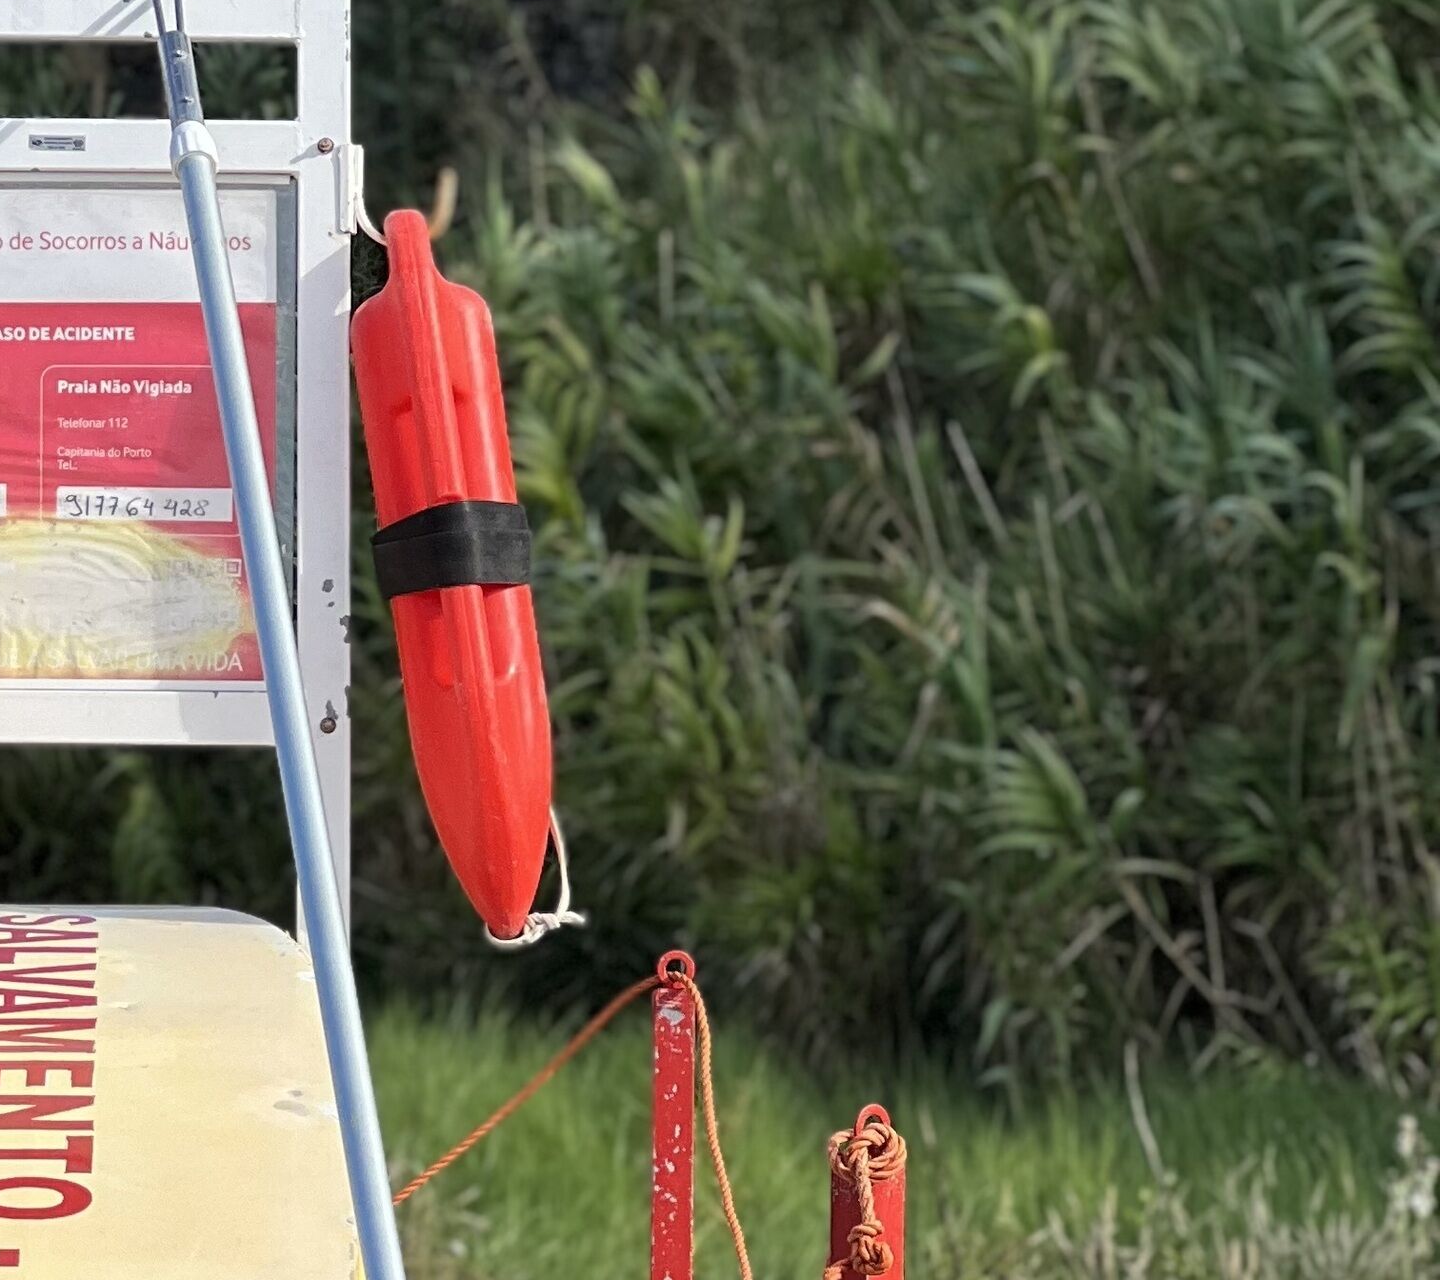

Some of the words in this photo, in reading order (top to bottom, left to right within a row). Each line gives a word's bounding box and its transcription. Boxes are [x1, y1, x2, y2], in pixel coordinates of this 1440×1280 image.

[9, 231, 34, 250] de
[39, 231, 127, 250] Socorros
[132, 235, 143, 250] a
[149, 231, 252, 251] Náuos
[28, 326, 49, 341] DE
[53, 326, 135, 341] ACIDENTE
[57, 379, 97, 394] Praia
[100, 378, 131, 394] Não
[133, 379, 192, 396] Vigiada
[57, 417, 106, 429] Telefonar
[108, 417, 129, 429] 112
[57, 446, 105, 459] Capitania
[107, 447, 121, 458] do
[123, 447, 152, 458] Porto
[194, 650, 244, 672] VIDA
